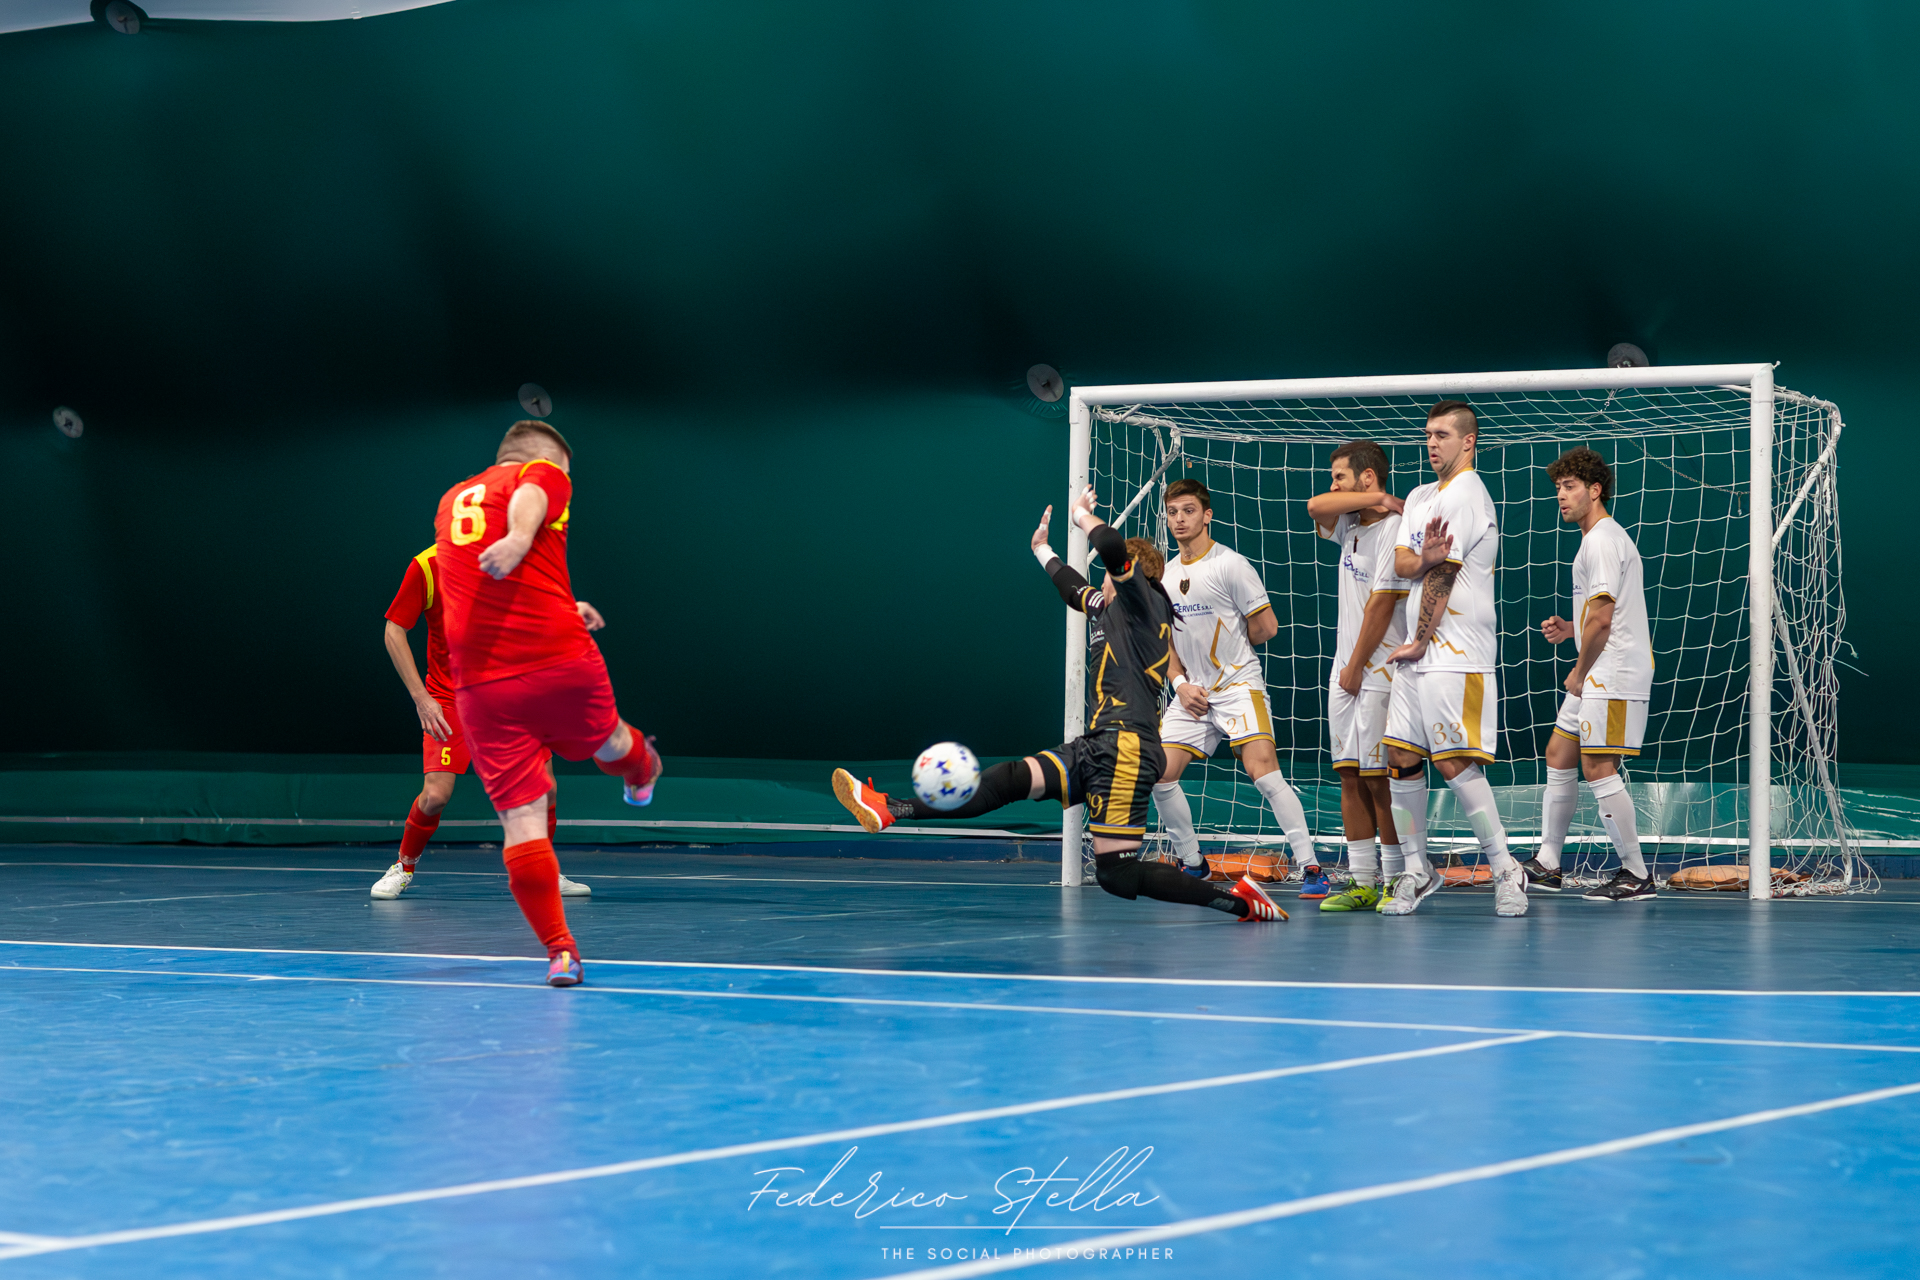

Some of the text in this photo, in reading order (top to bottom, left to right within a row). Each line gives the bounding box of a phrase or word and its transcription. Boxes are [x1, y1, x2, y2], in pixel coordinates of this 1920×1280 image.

[451, 484, 487, 546] 8
[1226, 712, 1251, 735] 21
[1432, 722, 1463, 746] 33
[1580, 720, 1592, 742] 9
[441, 746, 451, 766] 5
[1368, 741, 1382, 763] 4
